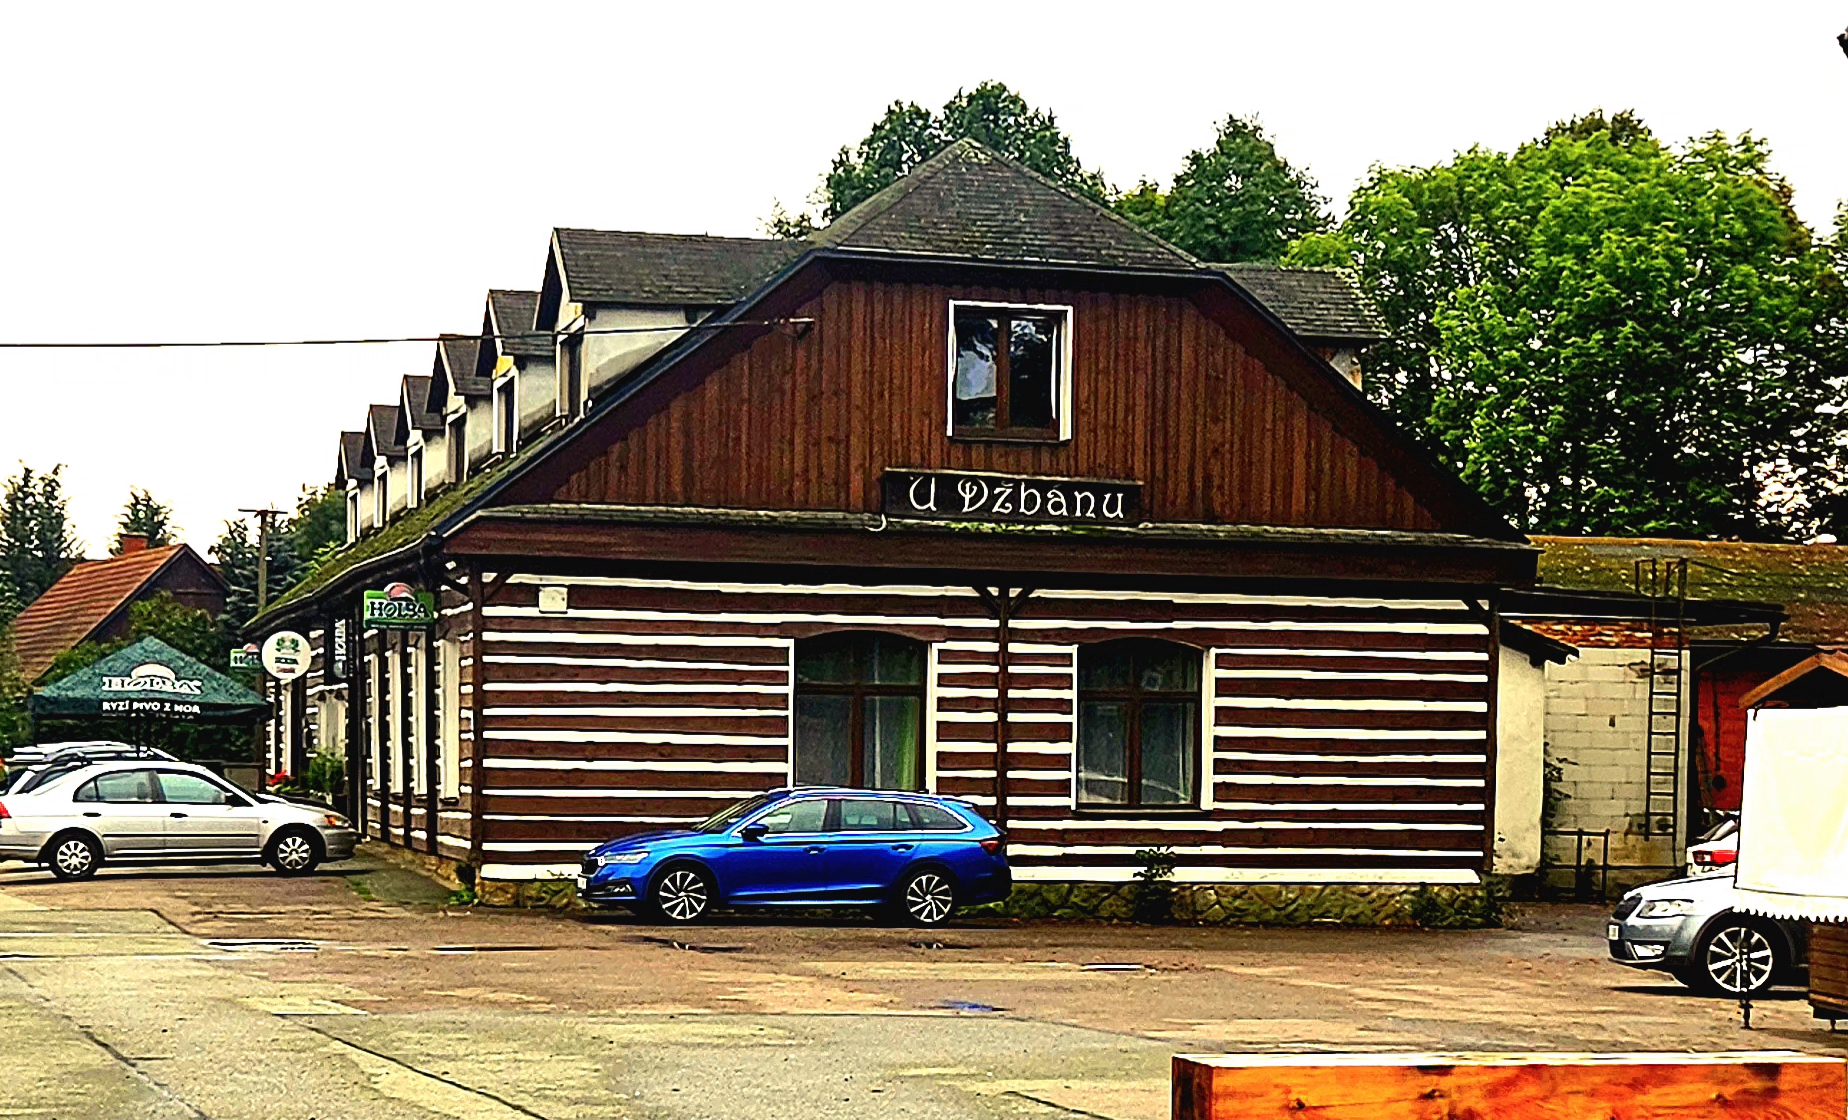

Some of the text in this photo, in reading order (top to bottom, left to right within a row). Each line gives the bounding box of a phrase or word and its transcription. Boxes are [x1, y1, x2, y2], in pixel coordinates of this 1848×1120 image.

[909, 475, 1124, 519] U Džbánu
[369, 601, 430, 619] HOLBA
[102, 700, 130, 711] RYZÍ
[132, 702, 160, 711] PIVO
[163, 703, 171, 712] Z
